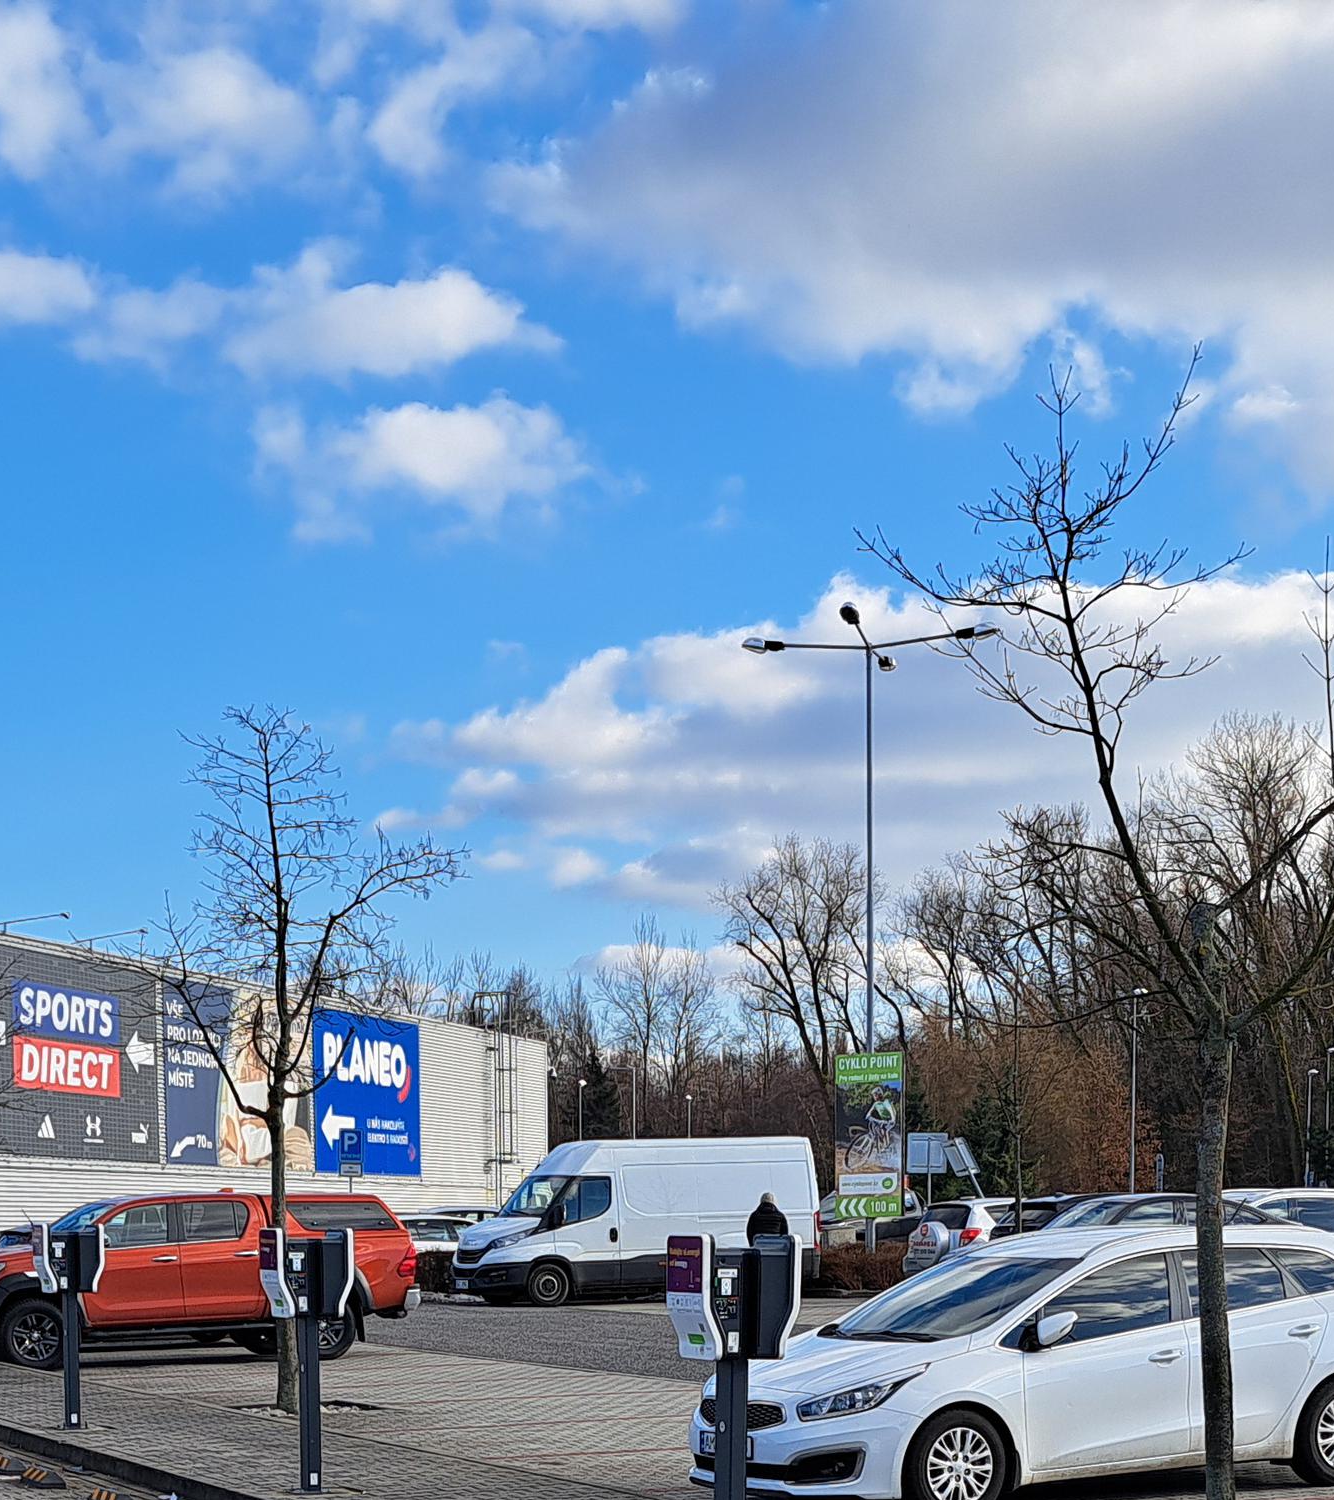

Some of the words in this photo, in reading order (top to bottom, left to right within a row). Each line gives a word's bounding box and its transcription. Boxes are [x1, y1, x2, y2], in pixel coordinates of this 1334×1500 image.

[20, 987, 113, 1037] SPORTS
[166, 999, 184, 1018] VŠE
[168, 1024, 186, 1043] PRO
[168, 1047, 181, 1064] NA
[323, 1032, 407, 1088] PLANEO
[839, 1056, 866, 1071] CYKLO
[870, 1055, 898, 1068] POINT
[22, 1043, 113, 1089] DIRECT
[168, 1068, 195, 1089] MÍSTĚ
[344, 1133, 357, 1152] P
[871, 1201, 886, 1212] 100
